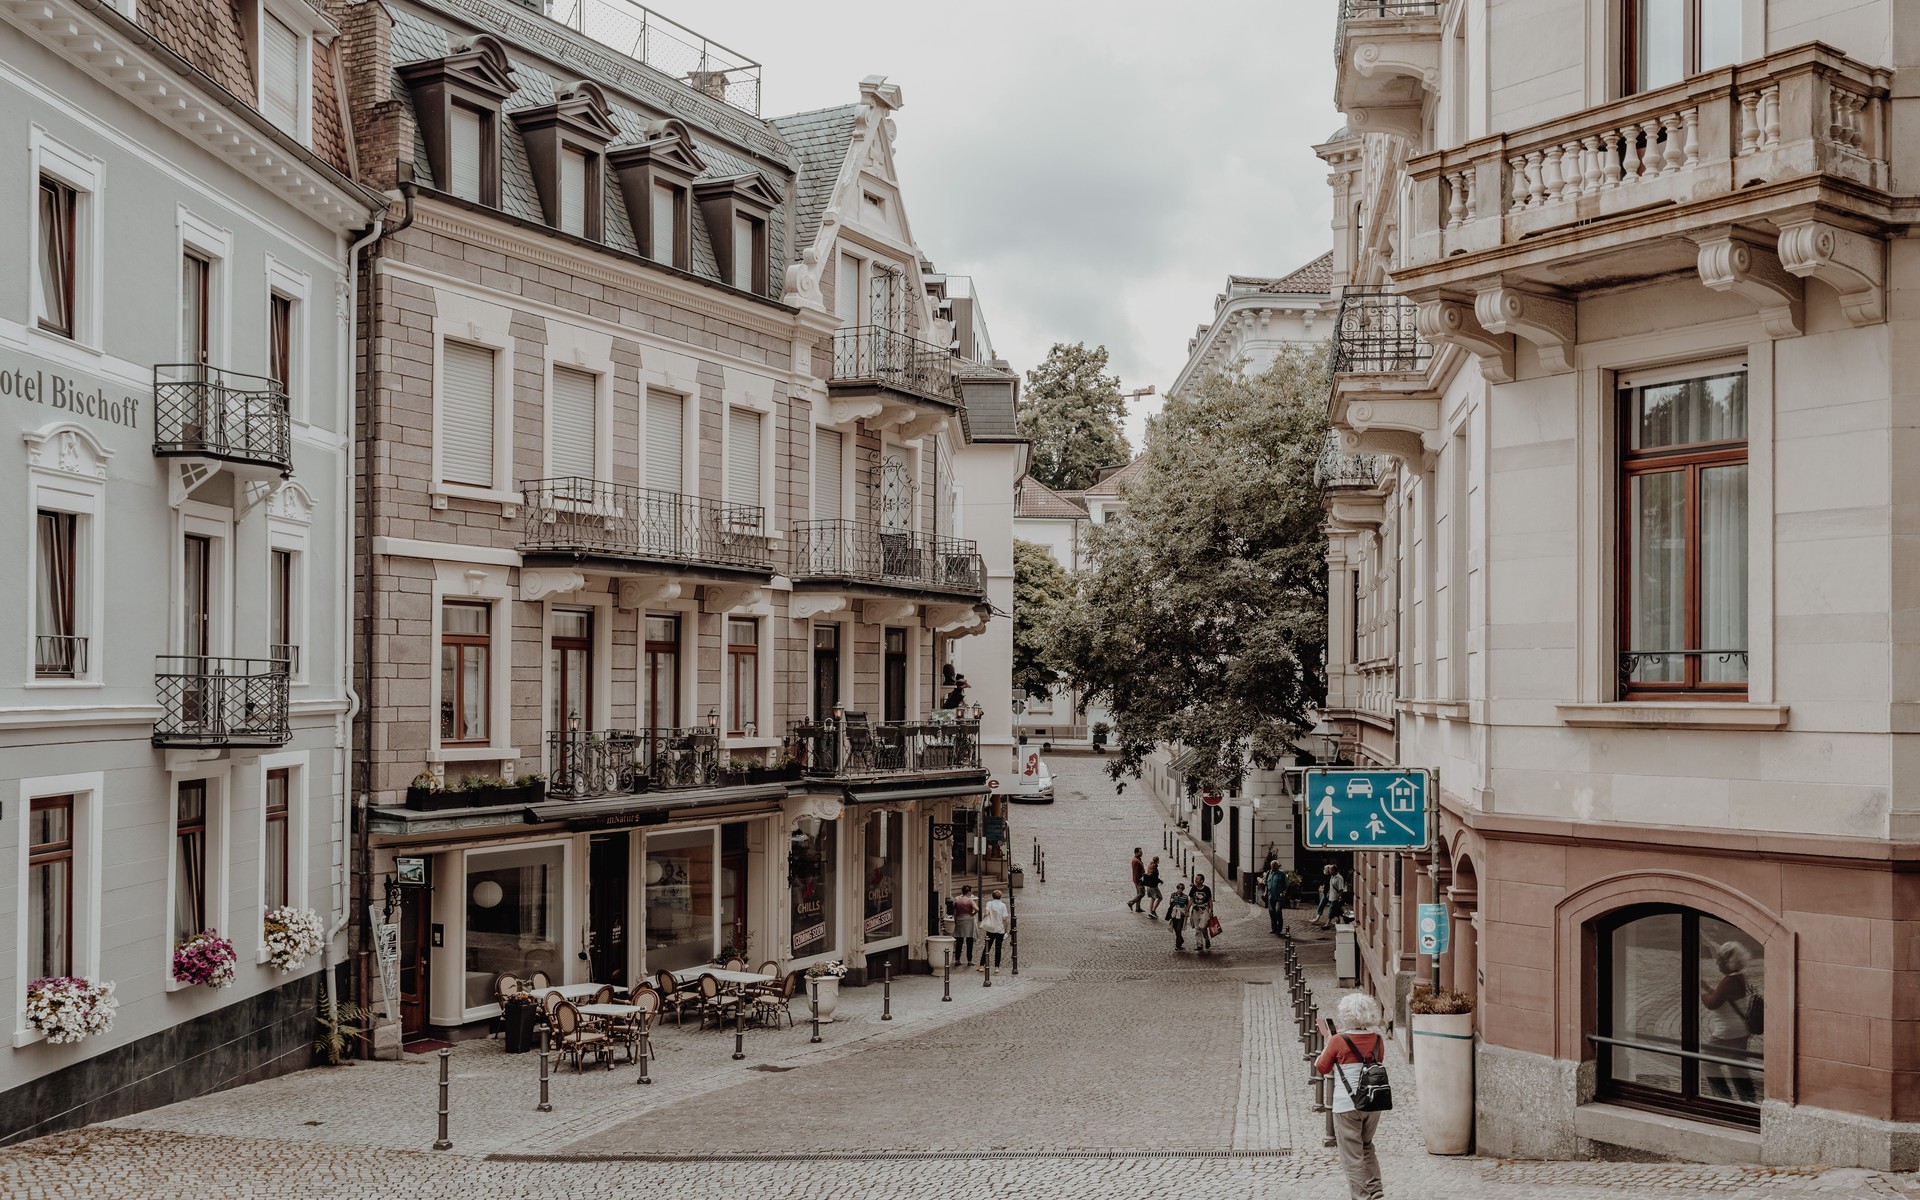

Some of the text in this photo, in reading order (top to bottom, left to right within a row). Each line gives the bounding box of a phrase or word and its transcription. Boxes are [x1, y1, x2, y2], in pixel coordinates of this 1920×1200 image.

[0, 368, 139, 428] otel Bischoff
[868, 888, 888, 900] CHILLS
[797, 900, 820, 913] CHILLS
[866, 912, 892, 930] COMING SOON
[795, 925, 824, 946] COMING SOON
